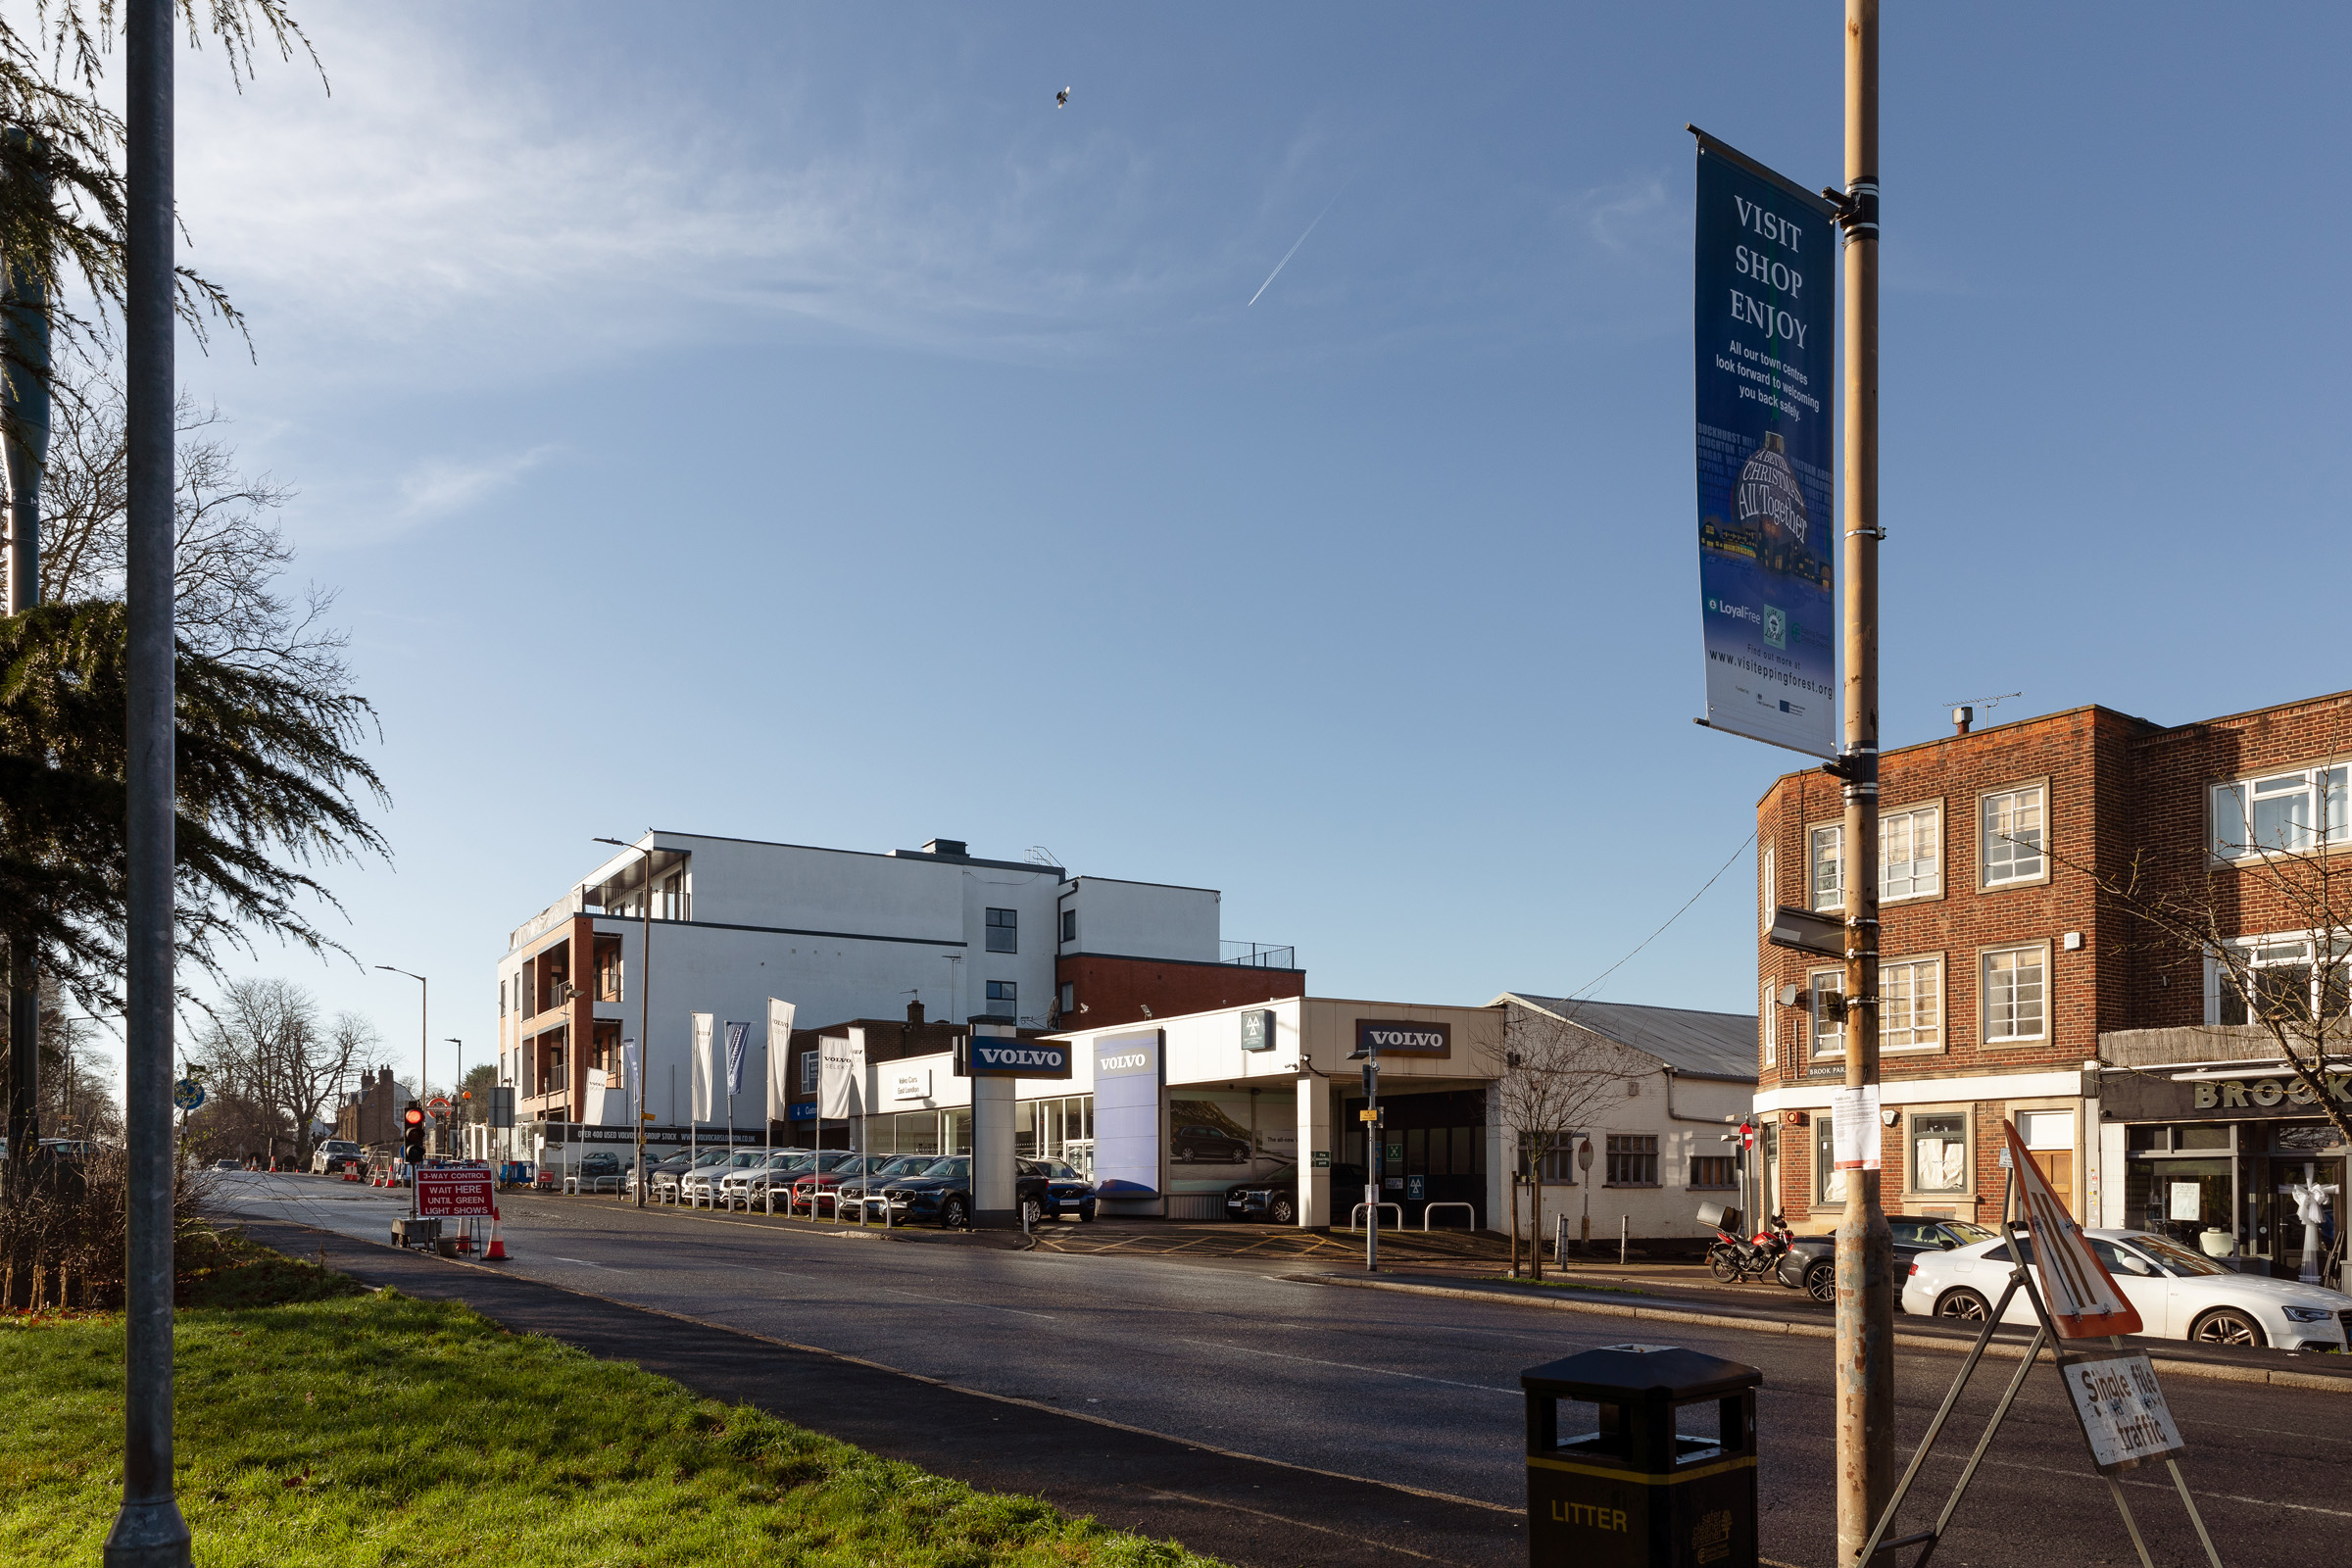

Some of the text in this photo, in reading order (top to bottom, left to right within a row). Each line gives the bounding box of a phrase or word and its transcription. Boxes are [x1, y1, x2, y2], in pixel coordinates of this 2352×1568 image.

[1734, 194, 1802, 254] VISIT
[1736, 244, 1803, 300] SHOP
[1730, 288, 1808, 350] ENJOY
[1729, 339, 1808, 386] All our town centres
[1716, 353, 1820, 414] look forward to welcoming
[1739, 384, 1801, 422] you back safely.
[1697, 422, 1740, 445] BUCKHURST
[1697, 434, 1736, 455] LOUGHTON
[1755, 449, 1766, 462] A
[1742, 460, 1804, 506] CHRISTMAS
[1739, 483, 1759, 520] All
[1759, 483, 1808, 545] Together
[1719, 600, 1761, 625] LoyalFree
[1747, 643, 1801, 670] Find out more at
[1709, 649, 1833, 701] www.visiteppingforest.org
[1369, 1031, 1444, 1047] VOLVO
[978, 1048, 1062, 1066] VOLVO
[1100, 1054, 1146, 1070] VOLVO
[1809, 1067, 1831, 1076] BROOK
[577, 1130, 592, 1139] OER
[592, 1130, 603, 1139] 400
[662, 1132, 677, 1141] STOCK
[455, 1185, 482, 1194] HERE
[2081, 1364, 2157, 1403] Single file
[2115, 1414, 2167, 1451] traffic
[1551, 1499, 1628, 1533] LITTER
[1693, 1520, 1722, 1537] cleaner
[1701, 1509, 1721, 1525] safer
[1691, 1530, 1722, 1549] greener
